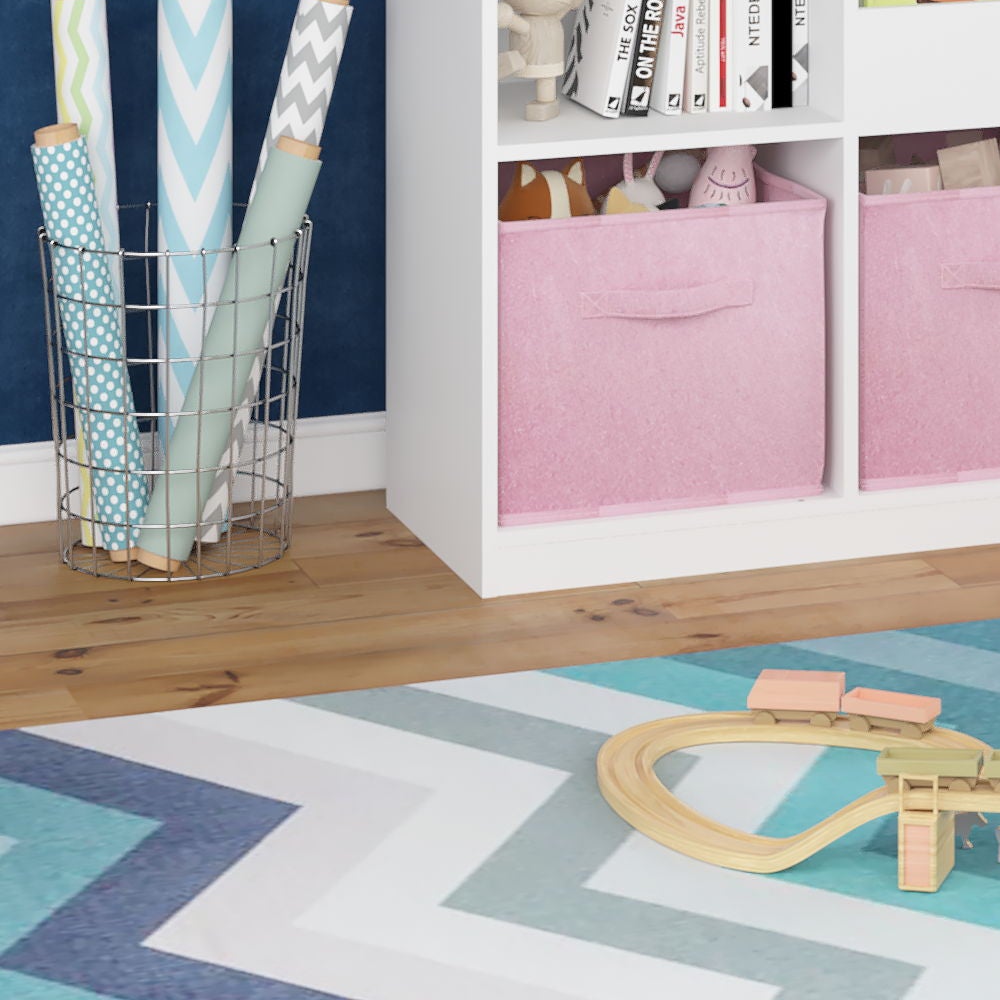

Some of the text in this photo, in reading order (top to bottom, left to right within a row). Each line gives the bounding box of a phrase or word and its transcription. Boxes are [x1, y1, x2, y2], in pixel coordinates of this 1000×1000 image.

[618, 5, 638, 61] THE SOX
[640, 25, 656, 51] THE
[671, 6, 686, 38] Java
[695, 30, 705, 73] Aptitude
[636, 64, 653, 79] ON
